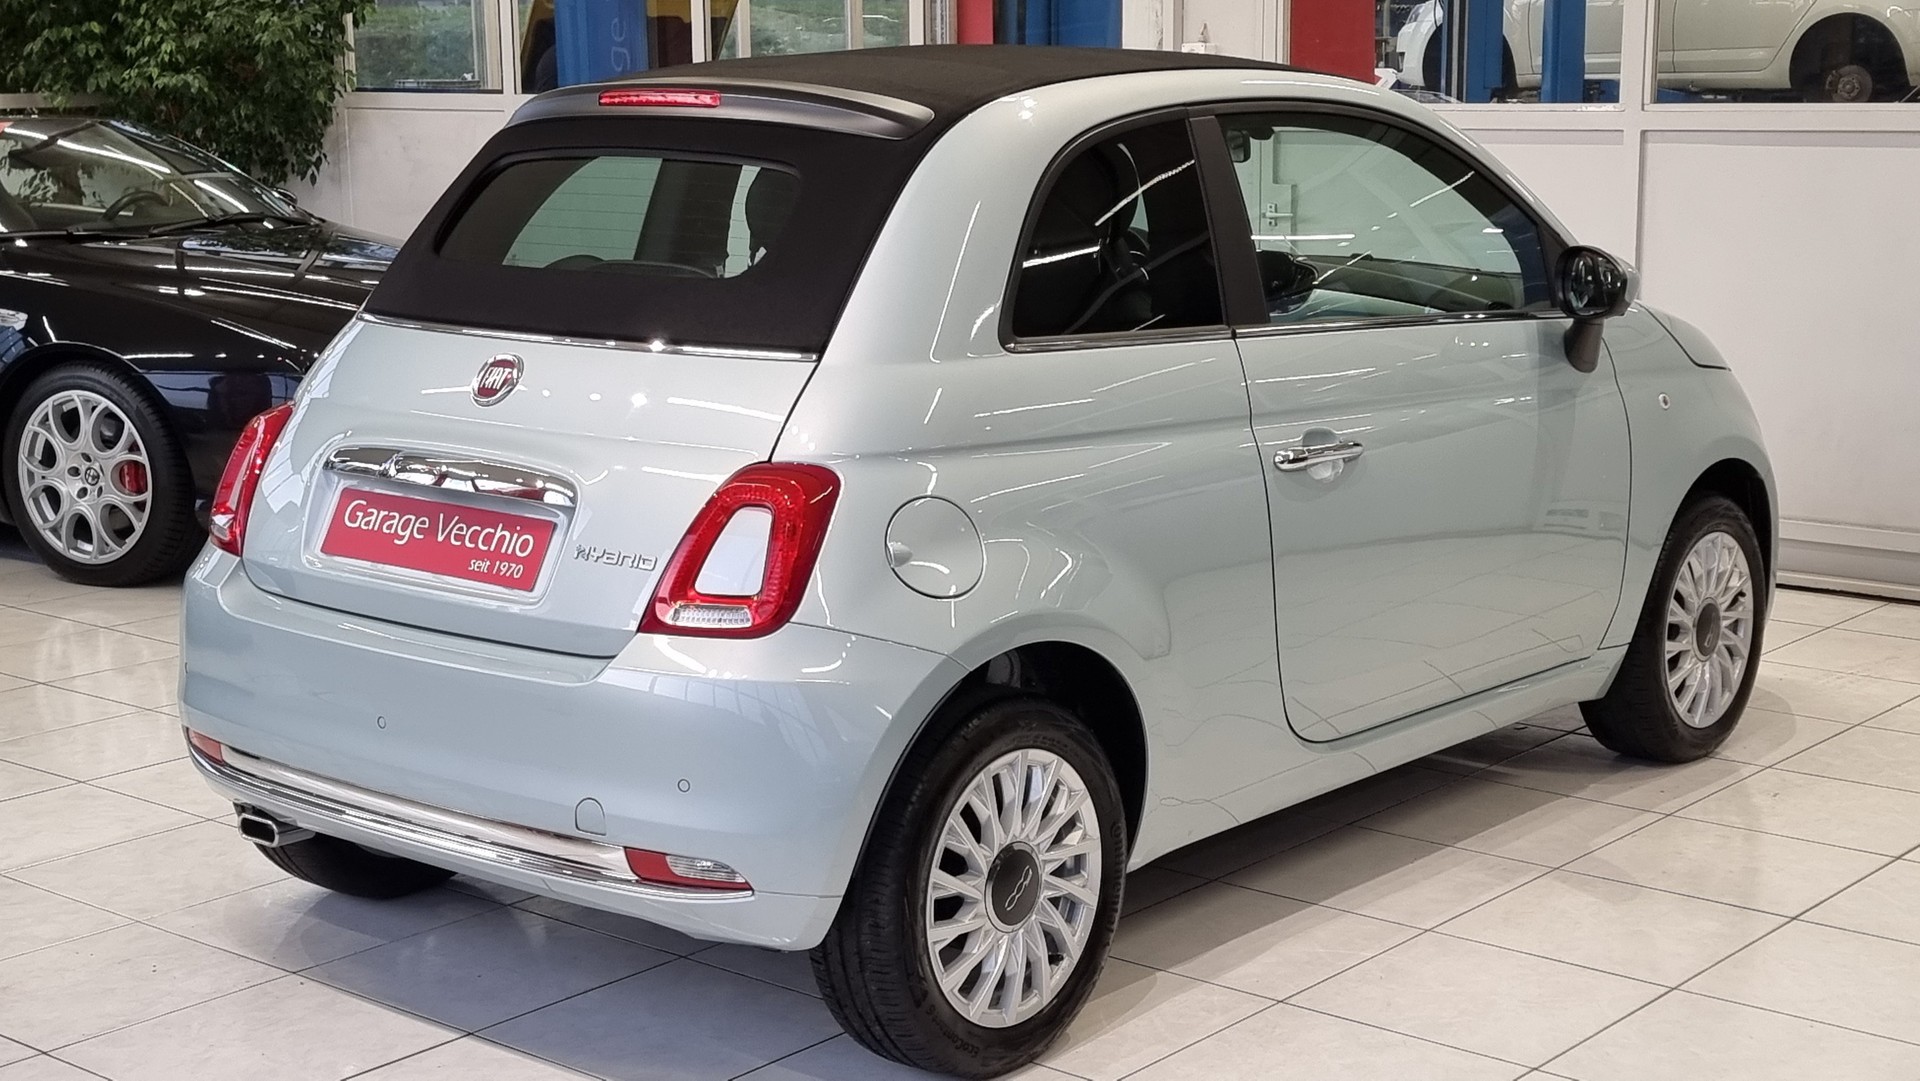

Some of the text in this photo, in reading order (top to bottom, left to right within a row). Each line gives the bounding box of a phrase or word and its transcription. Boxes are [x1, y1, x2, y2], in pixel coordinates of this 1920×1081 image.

[480, 366, 513, 390] FIAT
[343, 499, 534, 558] Garage Vecchio
[467, 558, 524, 579] seit 1970
[574, 544, 658, 571] HYBRID
